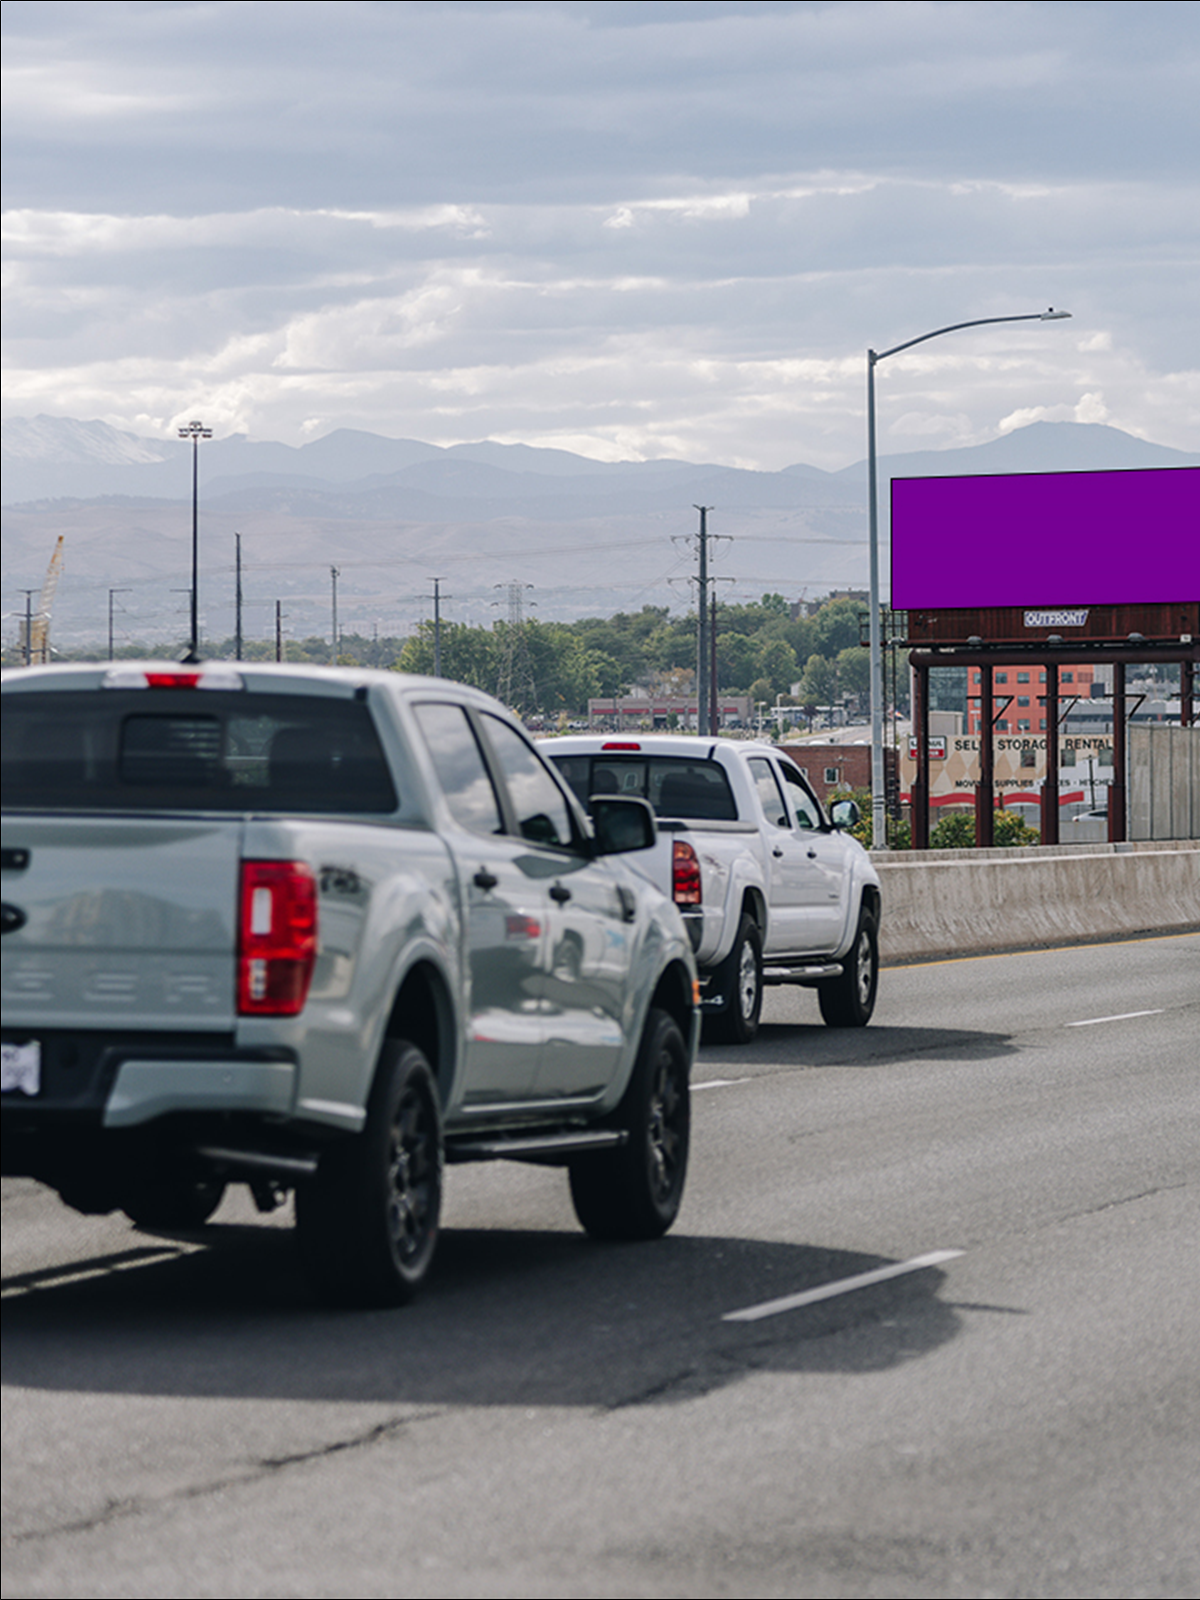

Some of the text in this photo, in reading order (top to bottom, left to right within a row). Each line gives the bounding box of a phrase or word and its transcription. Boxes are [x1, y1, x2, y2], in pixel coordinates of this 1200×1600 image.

[1026, 611, 1088, 626] OUTFRONT
[954, 739, 982, 751] SEL
[997, 738, 1048, 751] STORAG
[995, 779, 1034, 788] SUPPLIES
